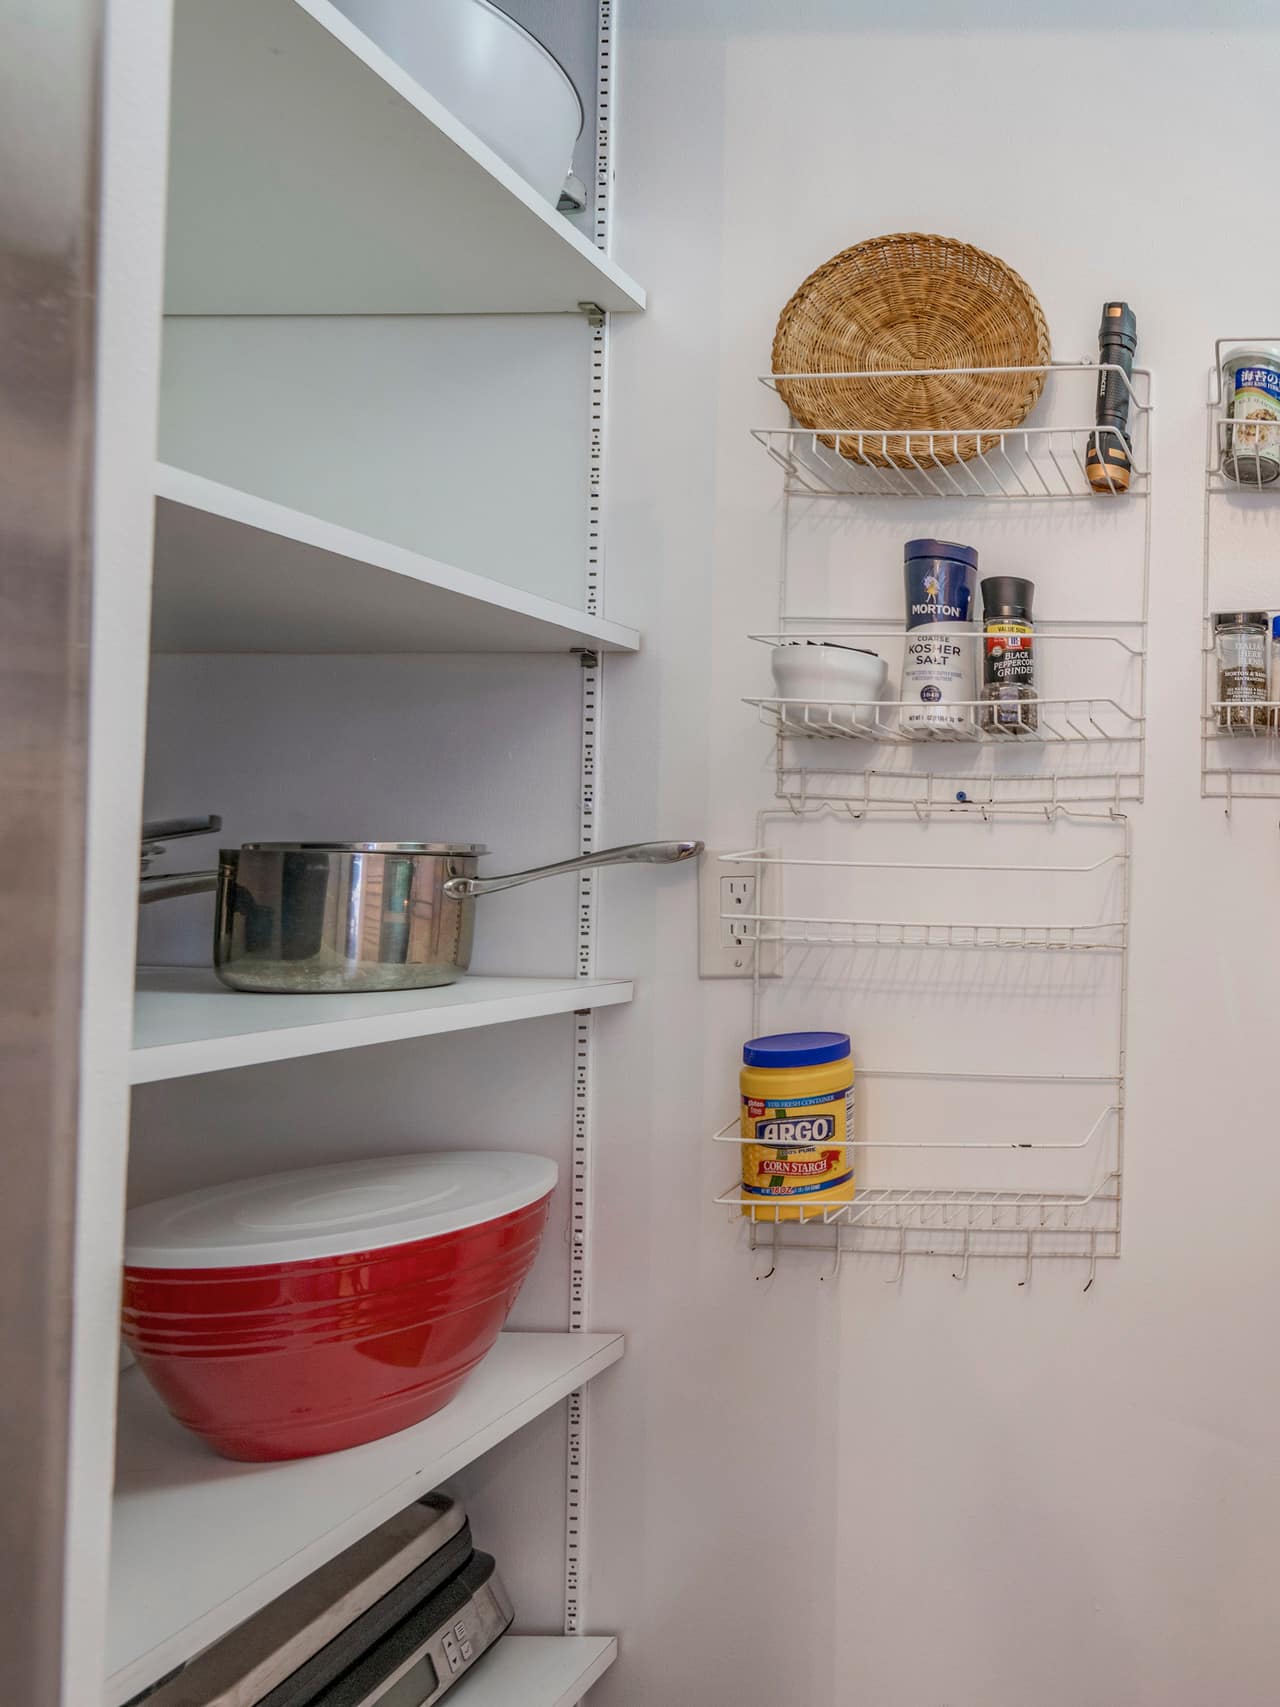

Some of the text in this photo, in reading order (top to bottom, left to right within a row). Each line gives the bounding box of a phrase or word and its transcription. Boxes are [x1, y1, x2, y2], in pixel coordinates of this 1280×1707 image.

[911, 603, 960, 618] MORTON
[908, 643, 961, 656] KOSHER
[1005, 651, 1029, 660] BLACK
[916, 656, 949, 665] SALT
[993, 659, 1032, 671] PEPPERCO
[764, 1119, 829, 1141] ARGO
[763, 1159, 827, 1172] CORN STARCH
